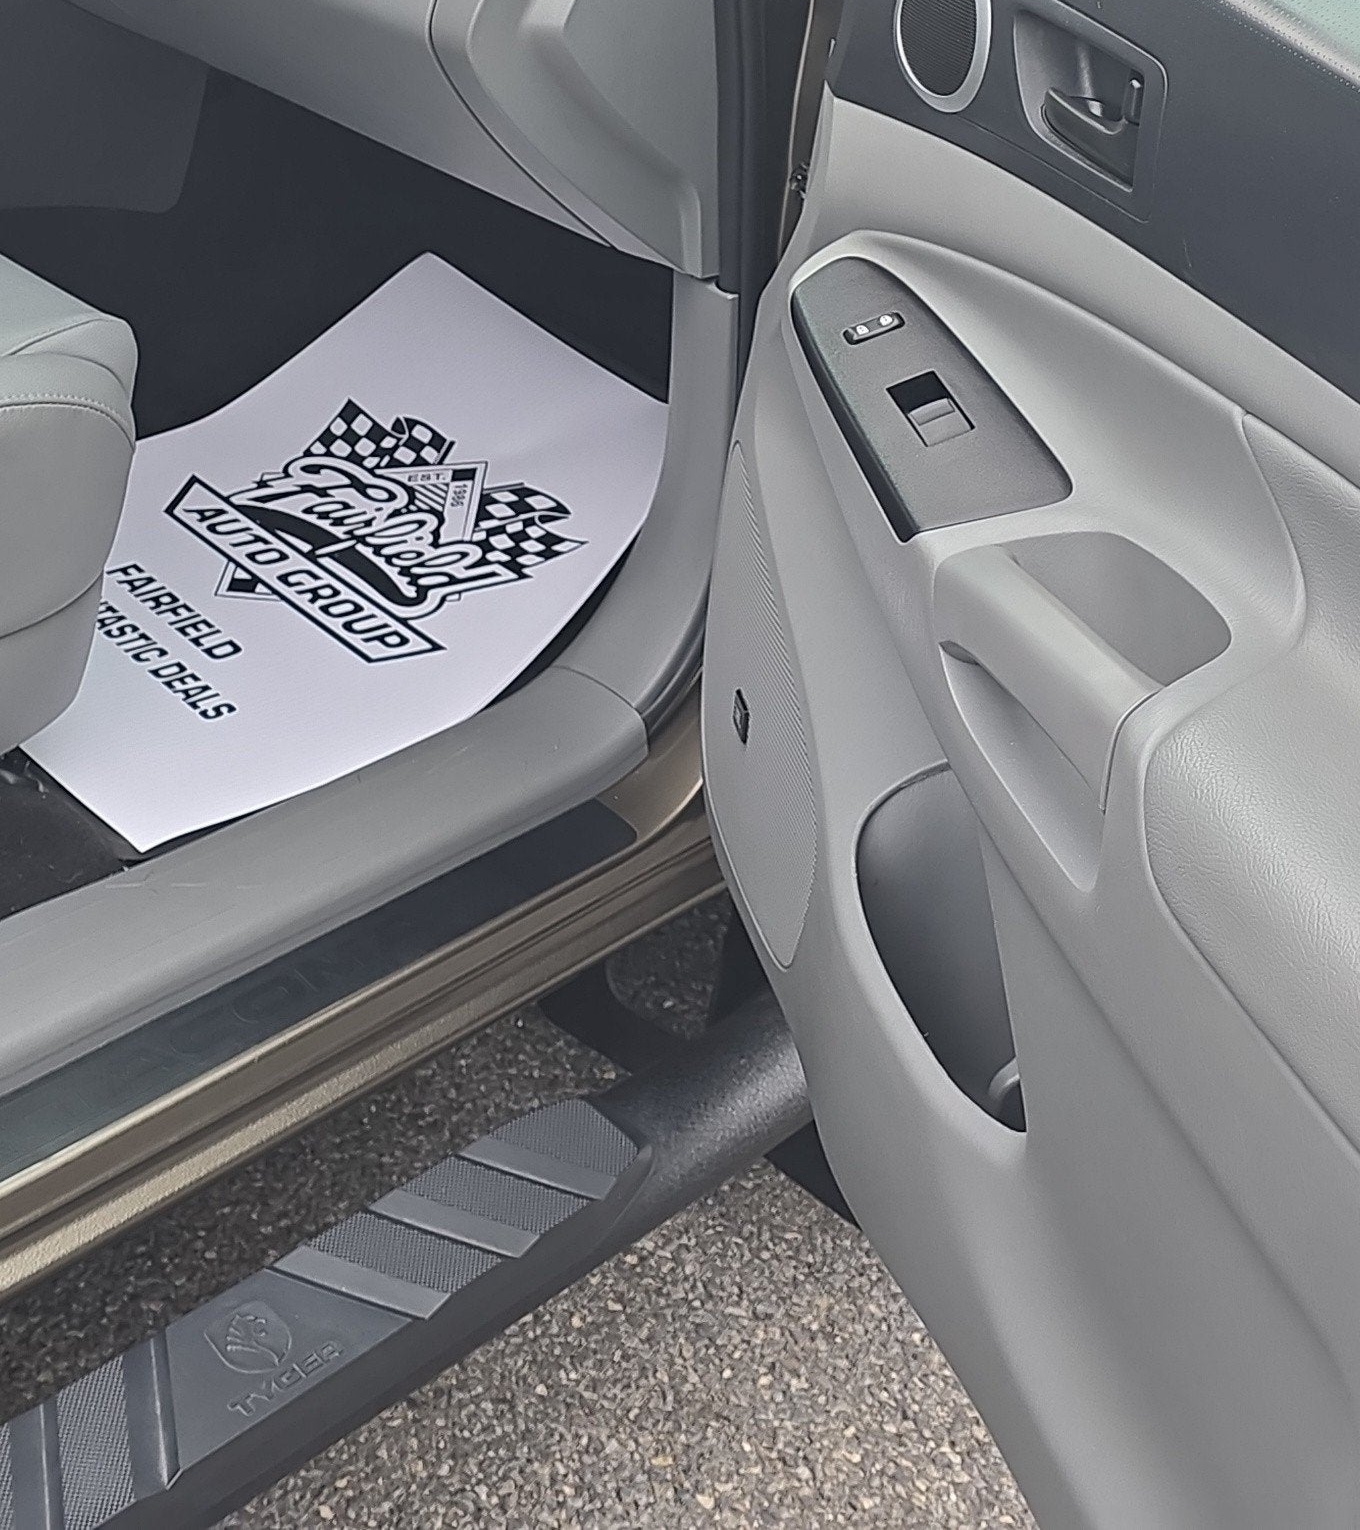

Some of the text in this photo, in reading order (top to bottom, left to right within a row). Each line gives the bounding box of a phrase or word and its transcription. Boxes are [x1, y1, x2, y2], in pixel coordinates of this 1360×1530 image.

[182, 504, 411, 648] AUTO GROUP
[246, 464, 506, 588] Fairfield
[97, 601, 238, 720] TASTIC DEALS
[106, 563, 243, 659] FAIRFIELD
